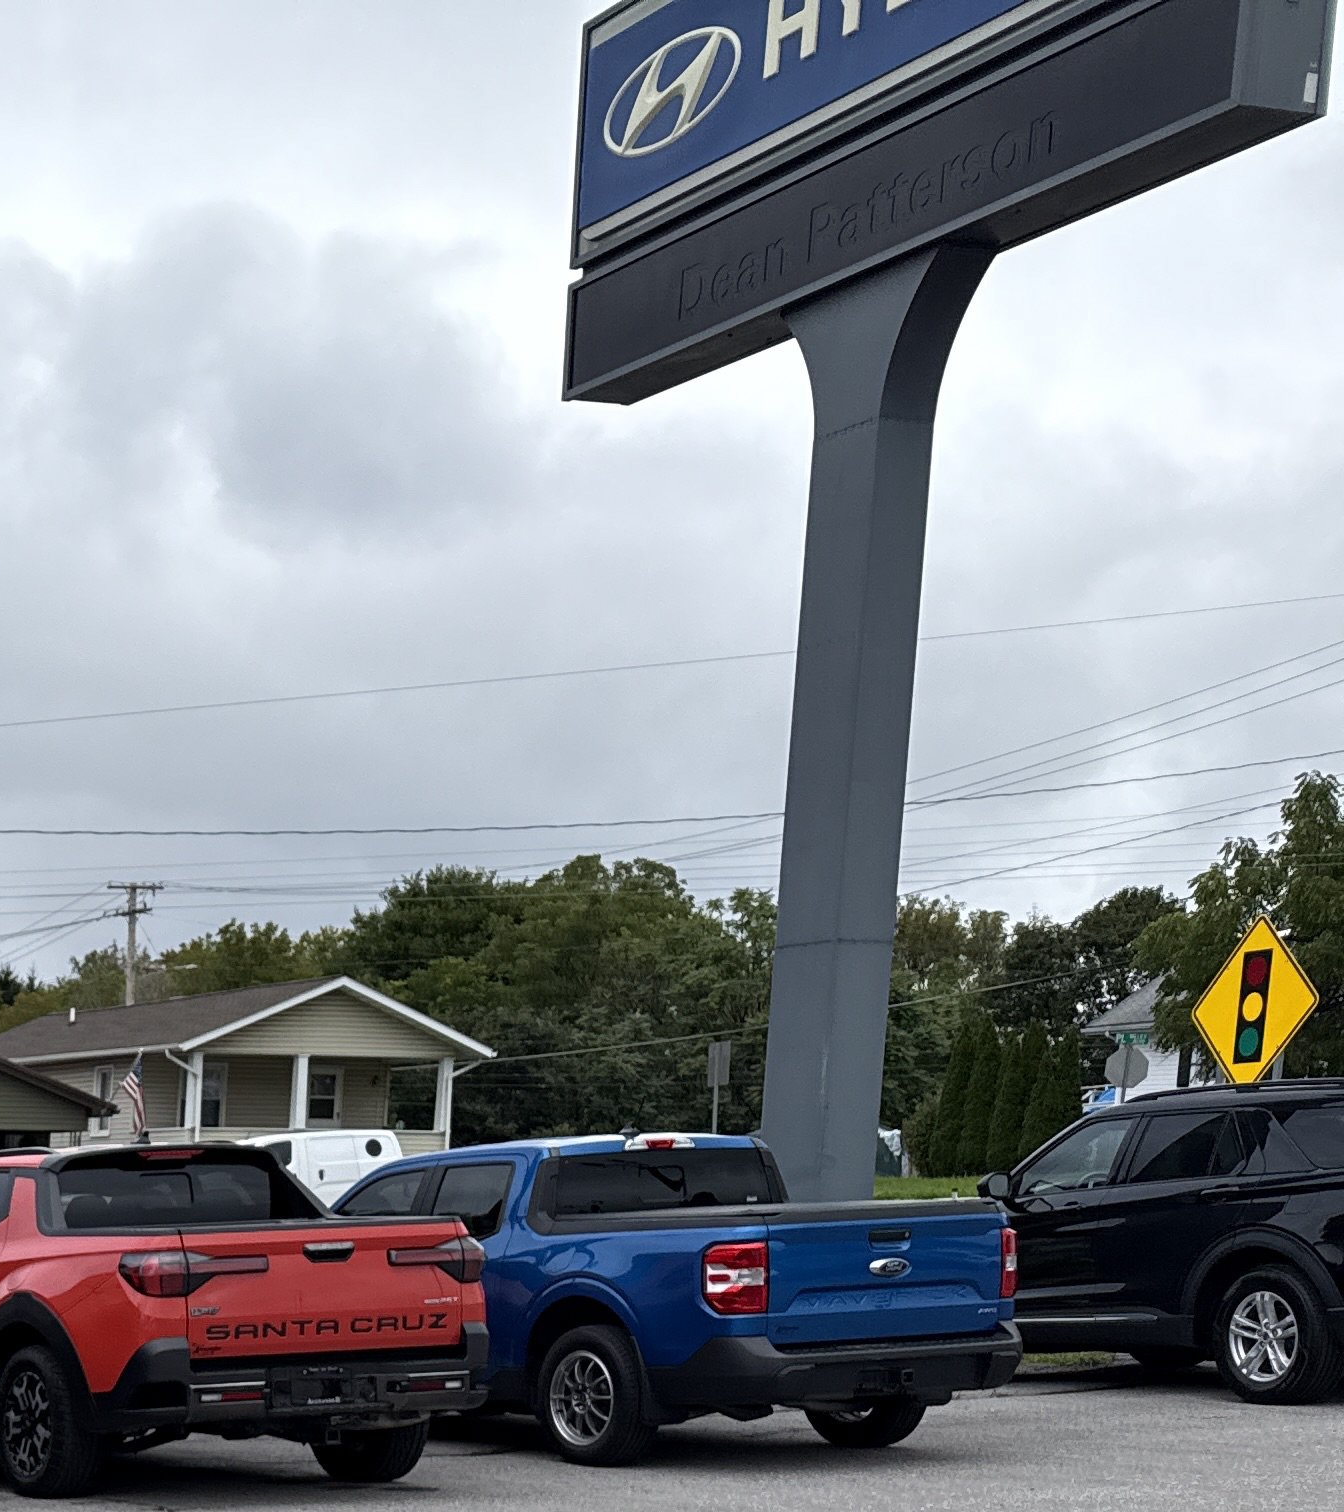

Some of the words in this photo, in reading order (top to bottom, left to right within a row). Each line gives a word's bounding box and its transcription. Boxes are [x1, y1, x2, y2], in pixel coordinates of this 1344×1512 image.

[678, 237, 785, 321] Dean
[806, 109, 1058, 263] Patterson
[206, 1319, 340, 1341] SANTA
[349, 1312, 448, 1334] CRUZ
